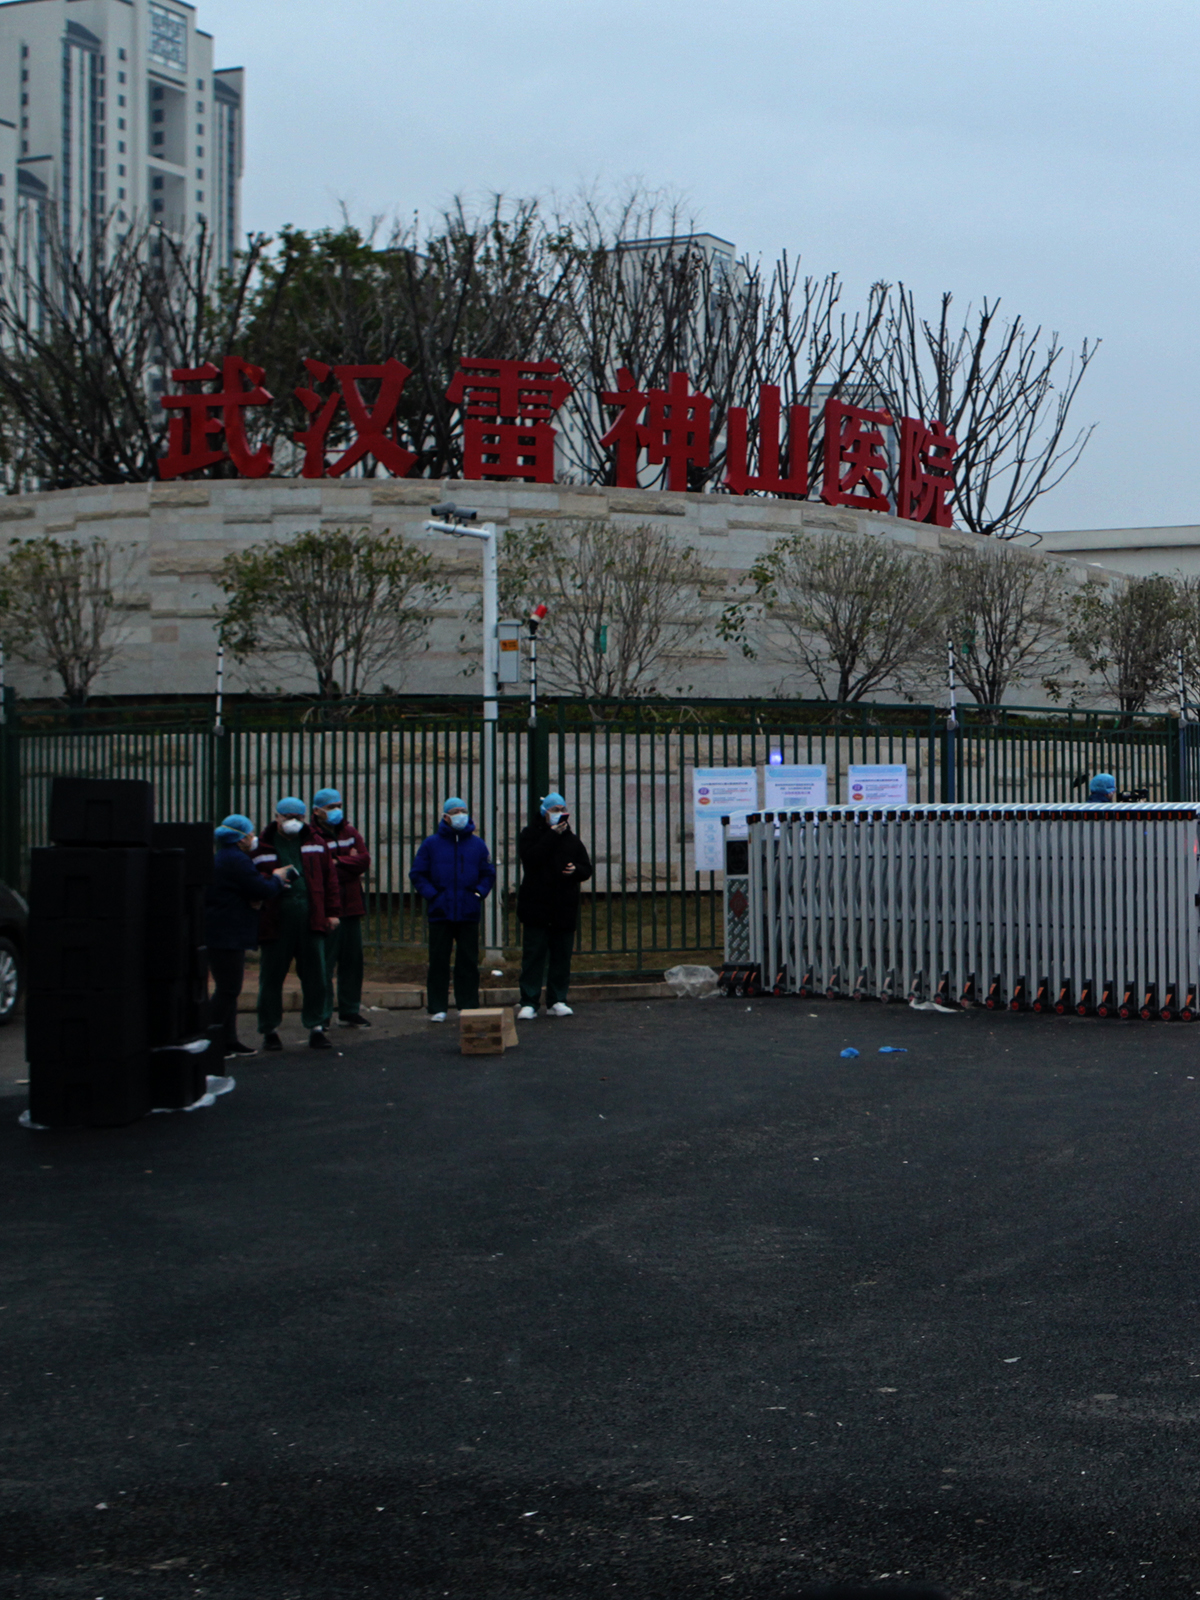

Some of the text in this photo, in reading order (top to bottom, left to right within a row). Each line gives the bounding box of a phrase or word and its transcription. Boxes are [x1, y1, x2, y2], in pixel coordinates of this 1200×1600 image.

[158, 355, 960, 528] 武汉雷神山医院
